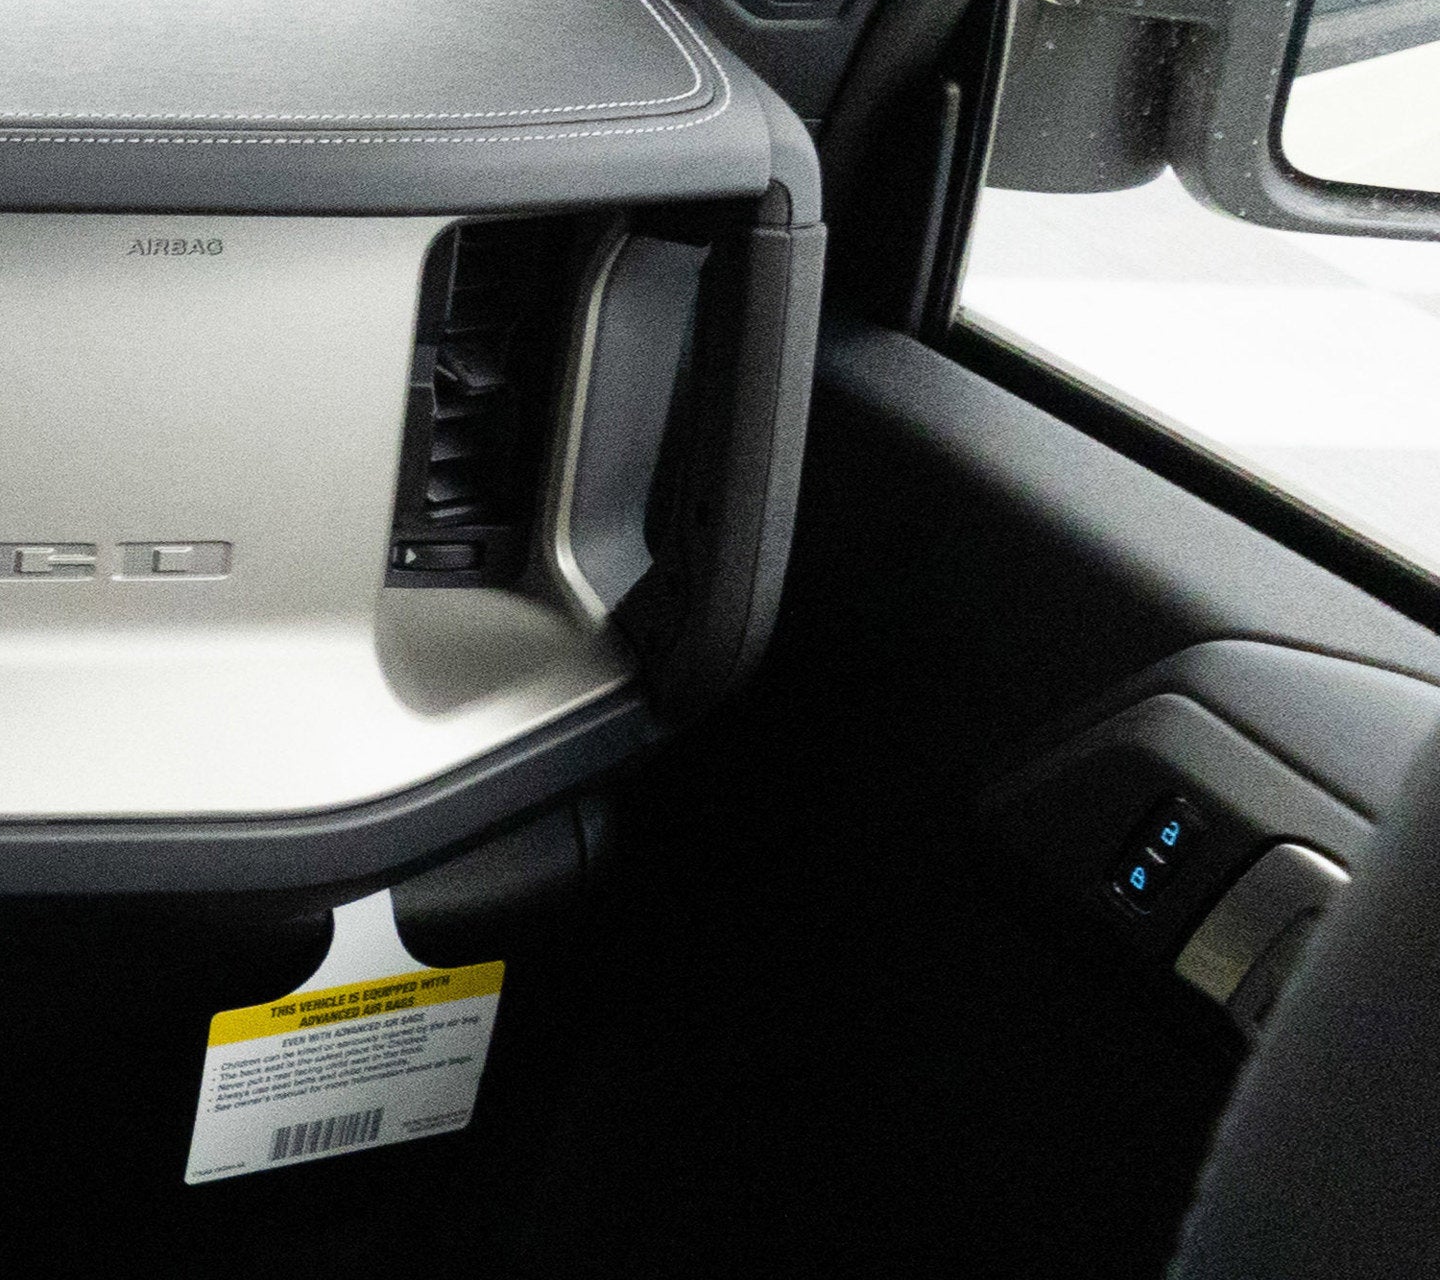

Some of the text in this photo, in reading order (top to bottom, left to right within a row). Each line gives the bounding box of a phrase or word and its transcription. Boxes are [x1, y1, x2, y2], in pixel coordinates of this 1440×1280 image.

[127, 237, 225, 256] AIRBAG
[270, 1003, 296, 1018] THIS
[298, 994, 346, 1013] VEHICLE
[347, 991, 360, 1003] IS
[362, 980, 417, 1000] EQUIPPED
